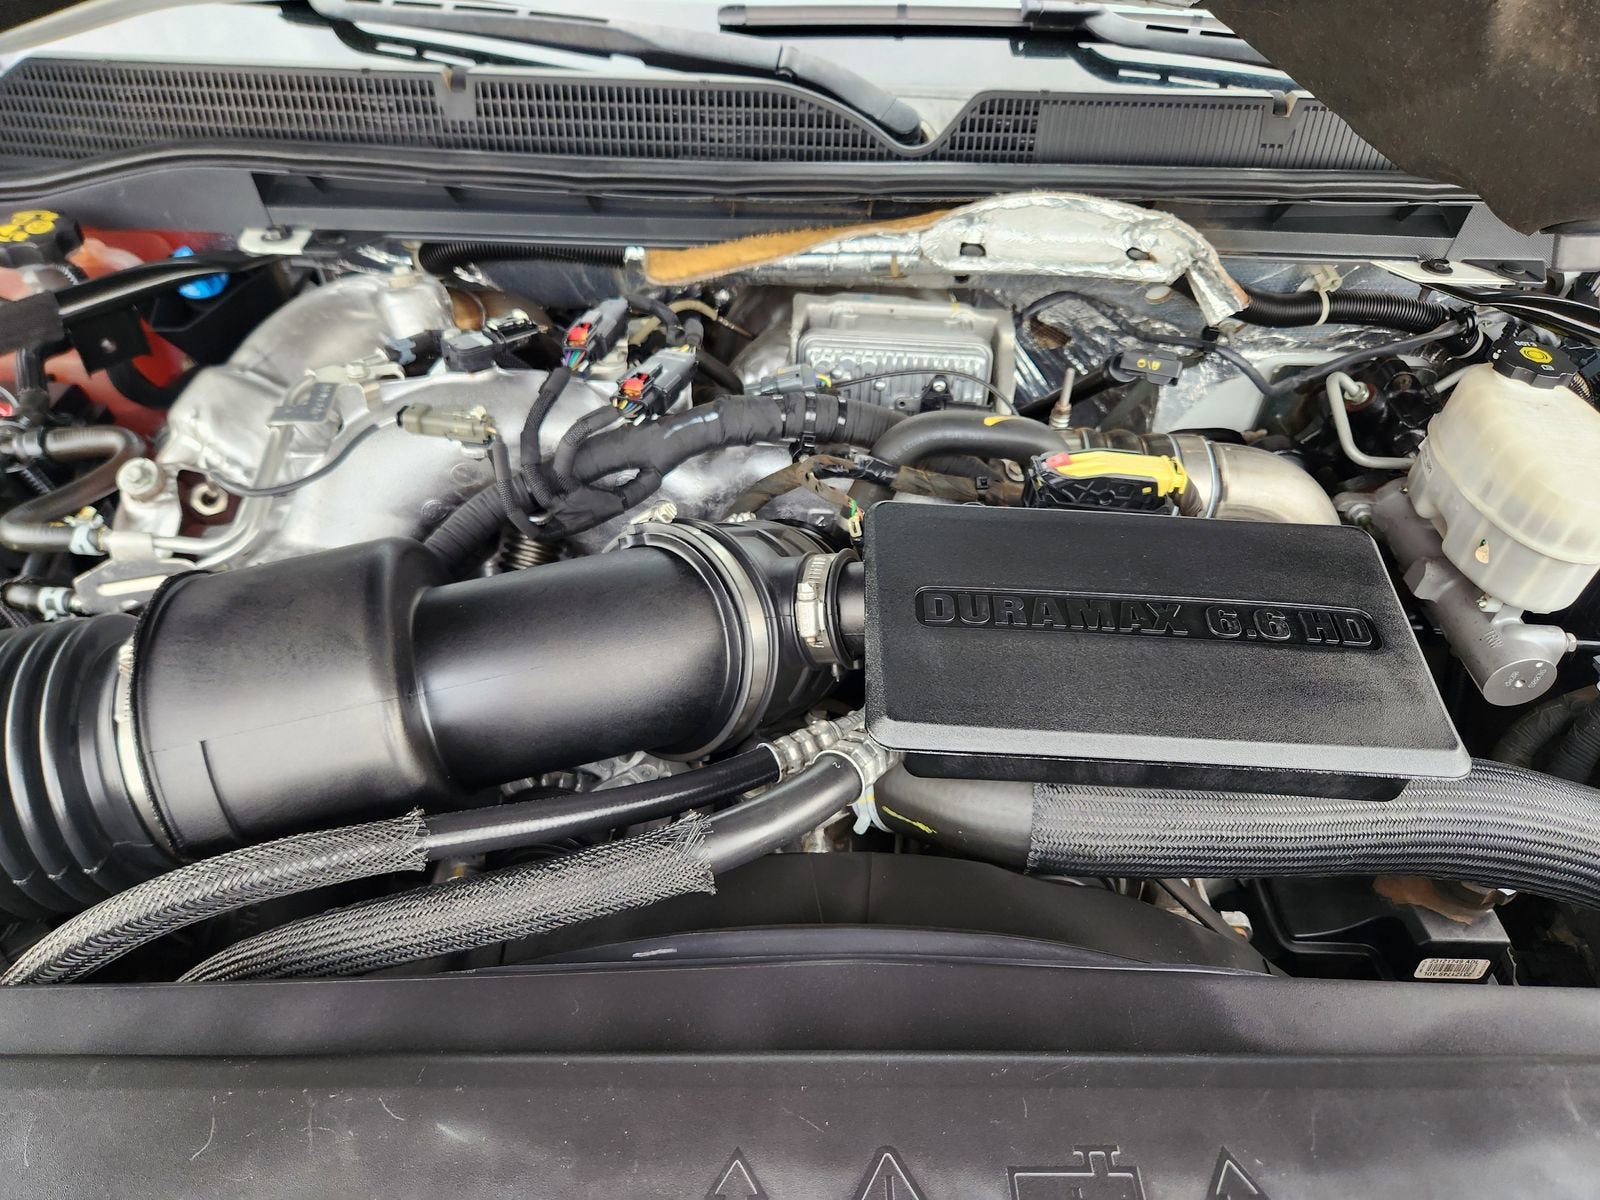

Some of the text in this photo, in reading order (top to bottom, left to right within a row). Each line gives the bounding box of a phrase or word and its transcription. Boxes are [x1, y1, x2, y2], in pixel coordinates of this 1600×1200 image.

[923, 592, 1373, 647] DURAMAX 6.6 HD
